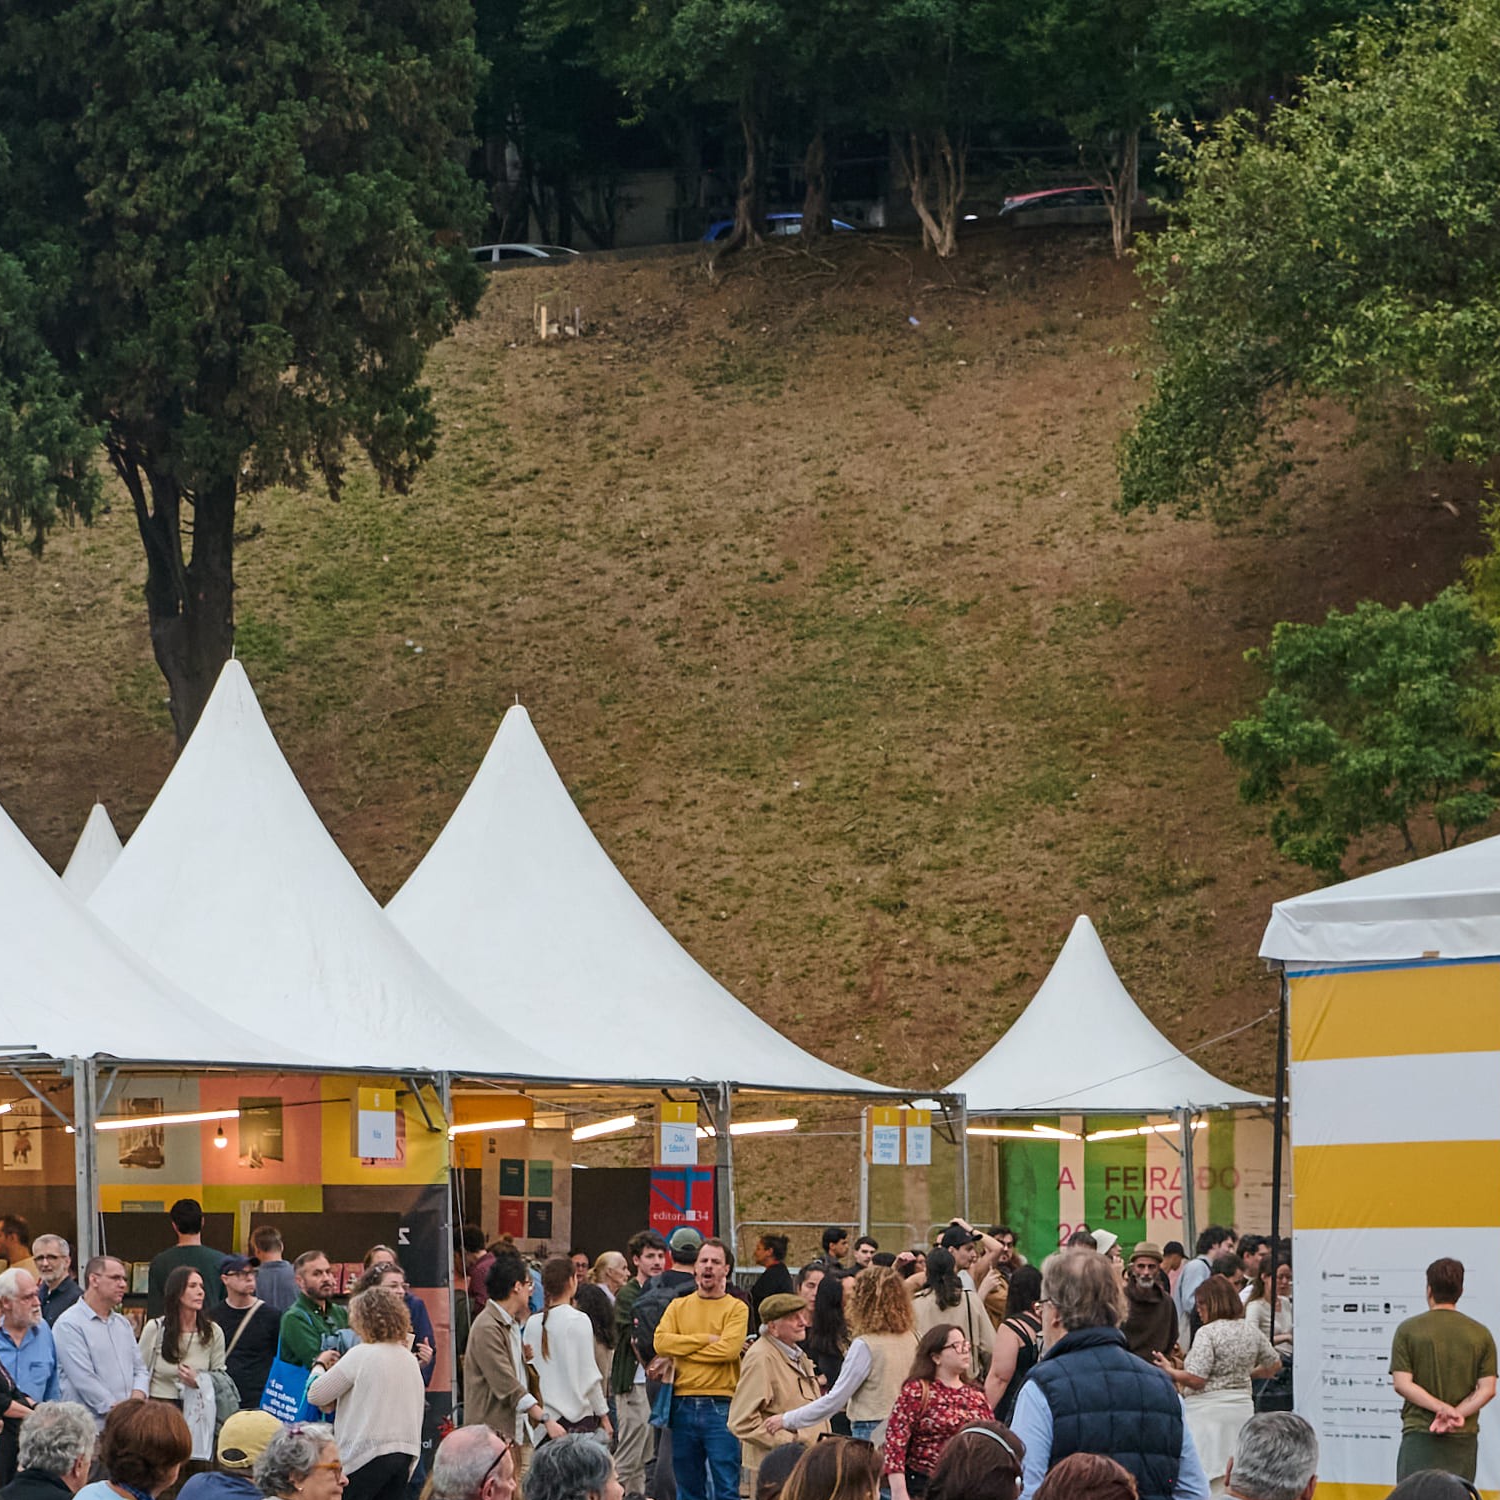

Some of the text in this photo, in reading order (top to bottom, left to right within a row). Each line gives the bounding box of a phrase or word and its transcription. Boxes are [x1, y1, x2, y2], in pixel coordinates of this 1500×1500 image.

[1056, 1166, 1076, 1191] A
[653, 1209, 709, 1222] editora 34
